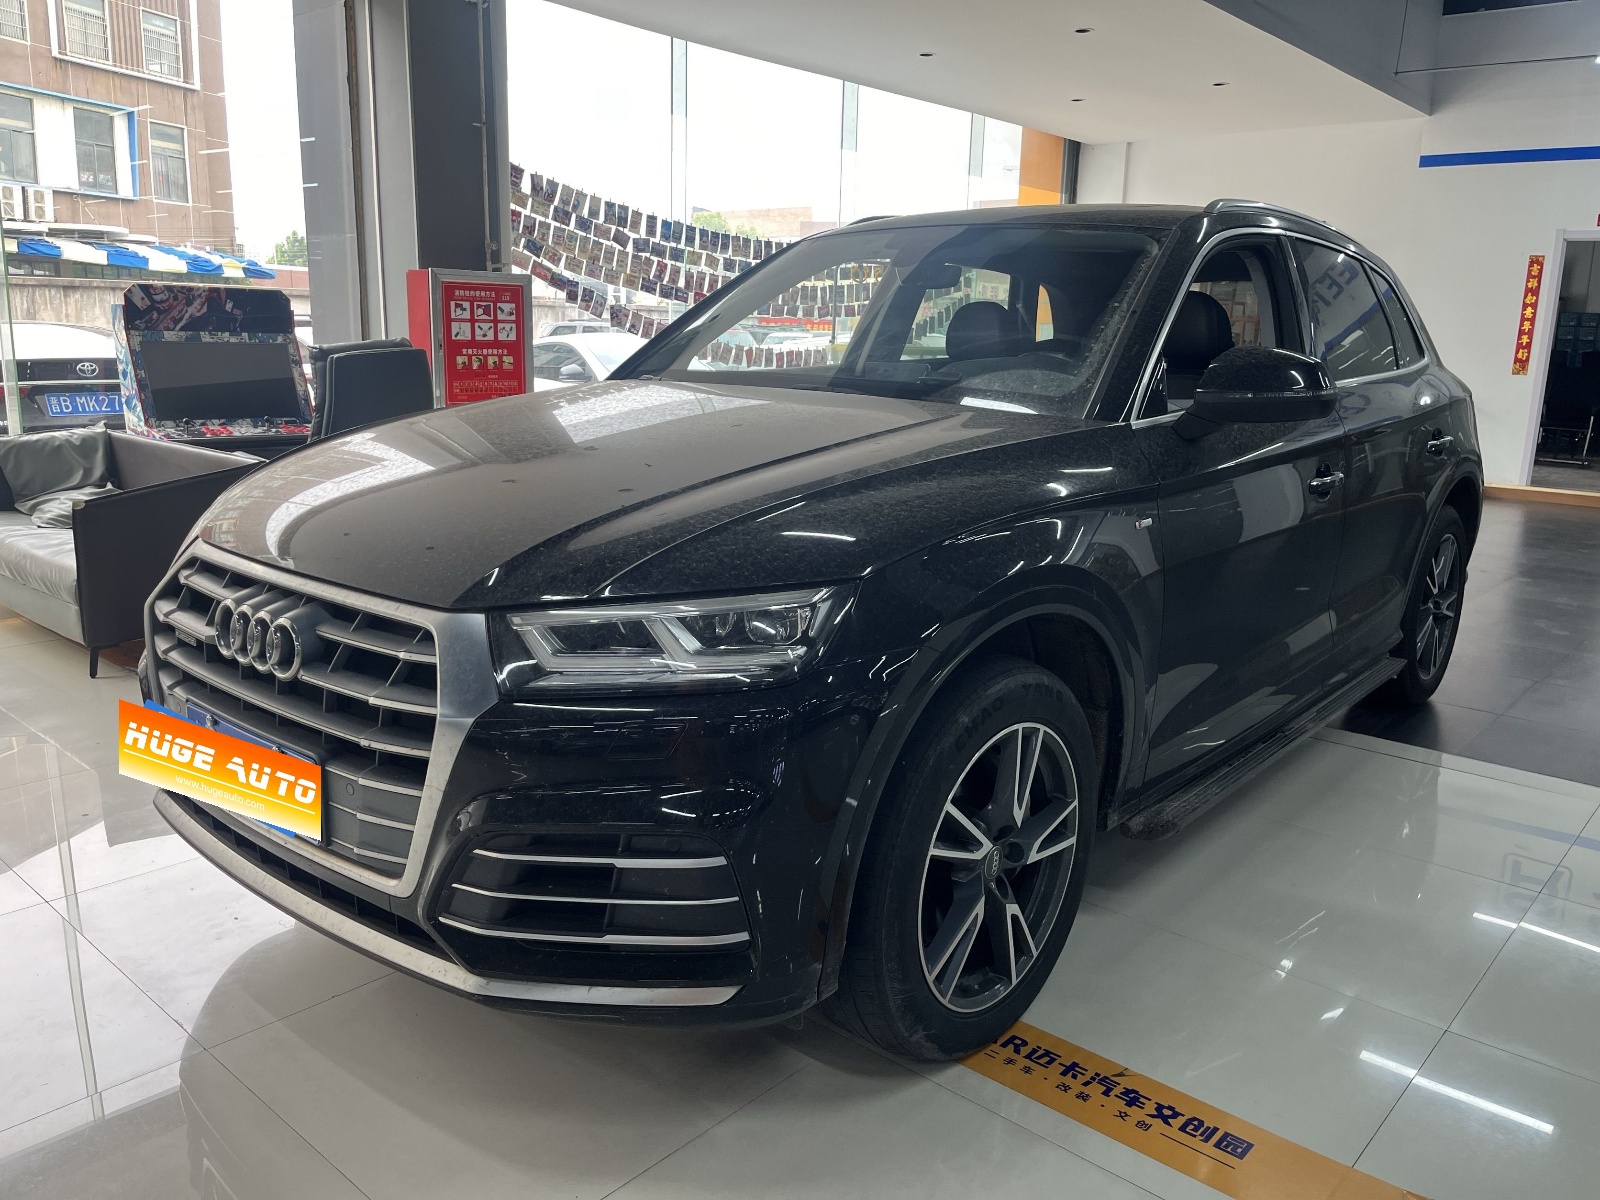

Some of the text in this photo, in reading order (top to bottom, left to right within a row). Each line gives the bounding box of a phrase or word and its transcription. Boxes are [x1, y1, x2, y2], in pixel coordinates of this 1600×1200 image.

[49, 395, 120, 413] 晋B·MK27
[992, 1034, 1255, 1161] R迈卡汽车文创园
